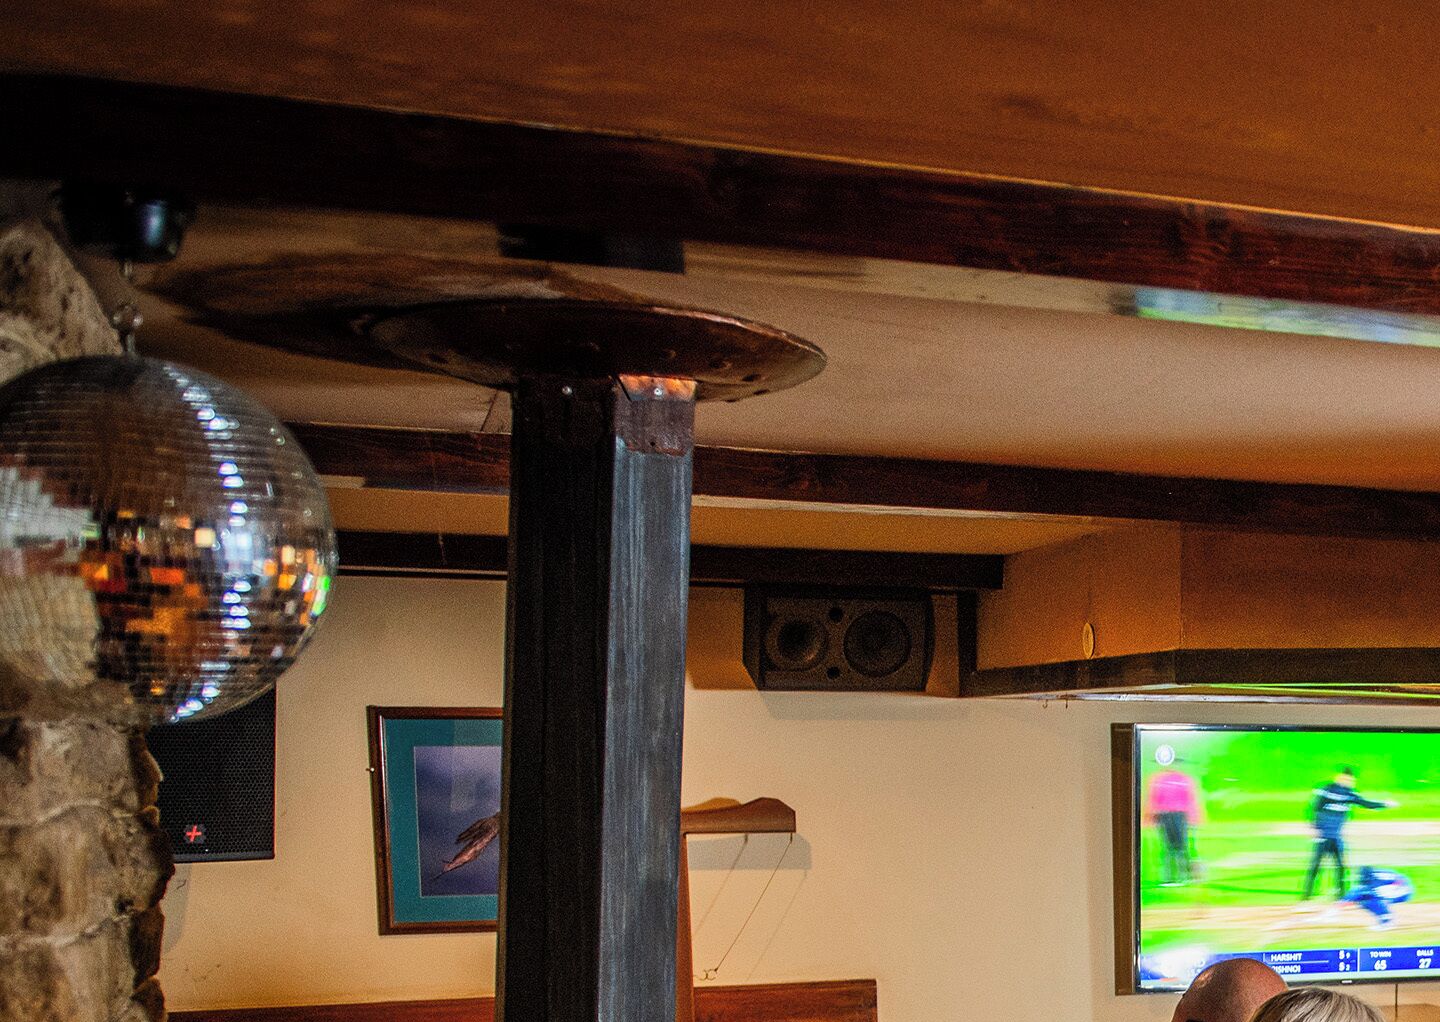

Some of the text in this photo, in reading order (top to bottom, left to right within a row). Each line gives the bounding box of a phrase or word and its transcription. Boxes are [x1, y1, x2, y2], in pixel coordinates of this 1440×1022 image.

[1271, 953, 1302, 962] HARSHIT
[1416, 949, 1434, 957] BALLS
[1418, 958, 1432, 969] 27
